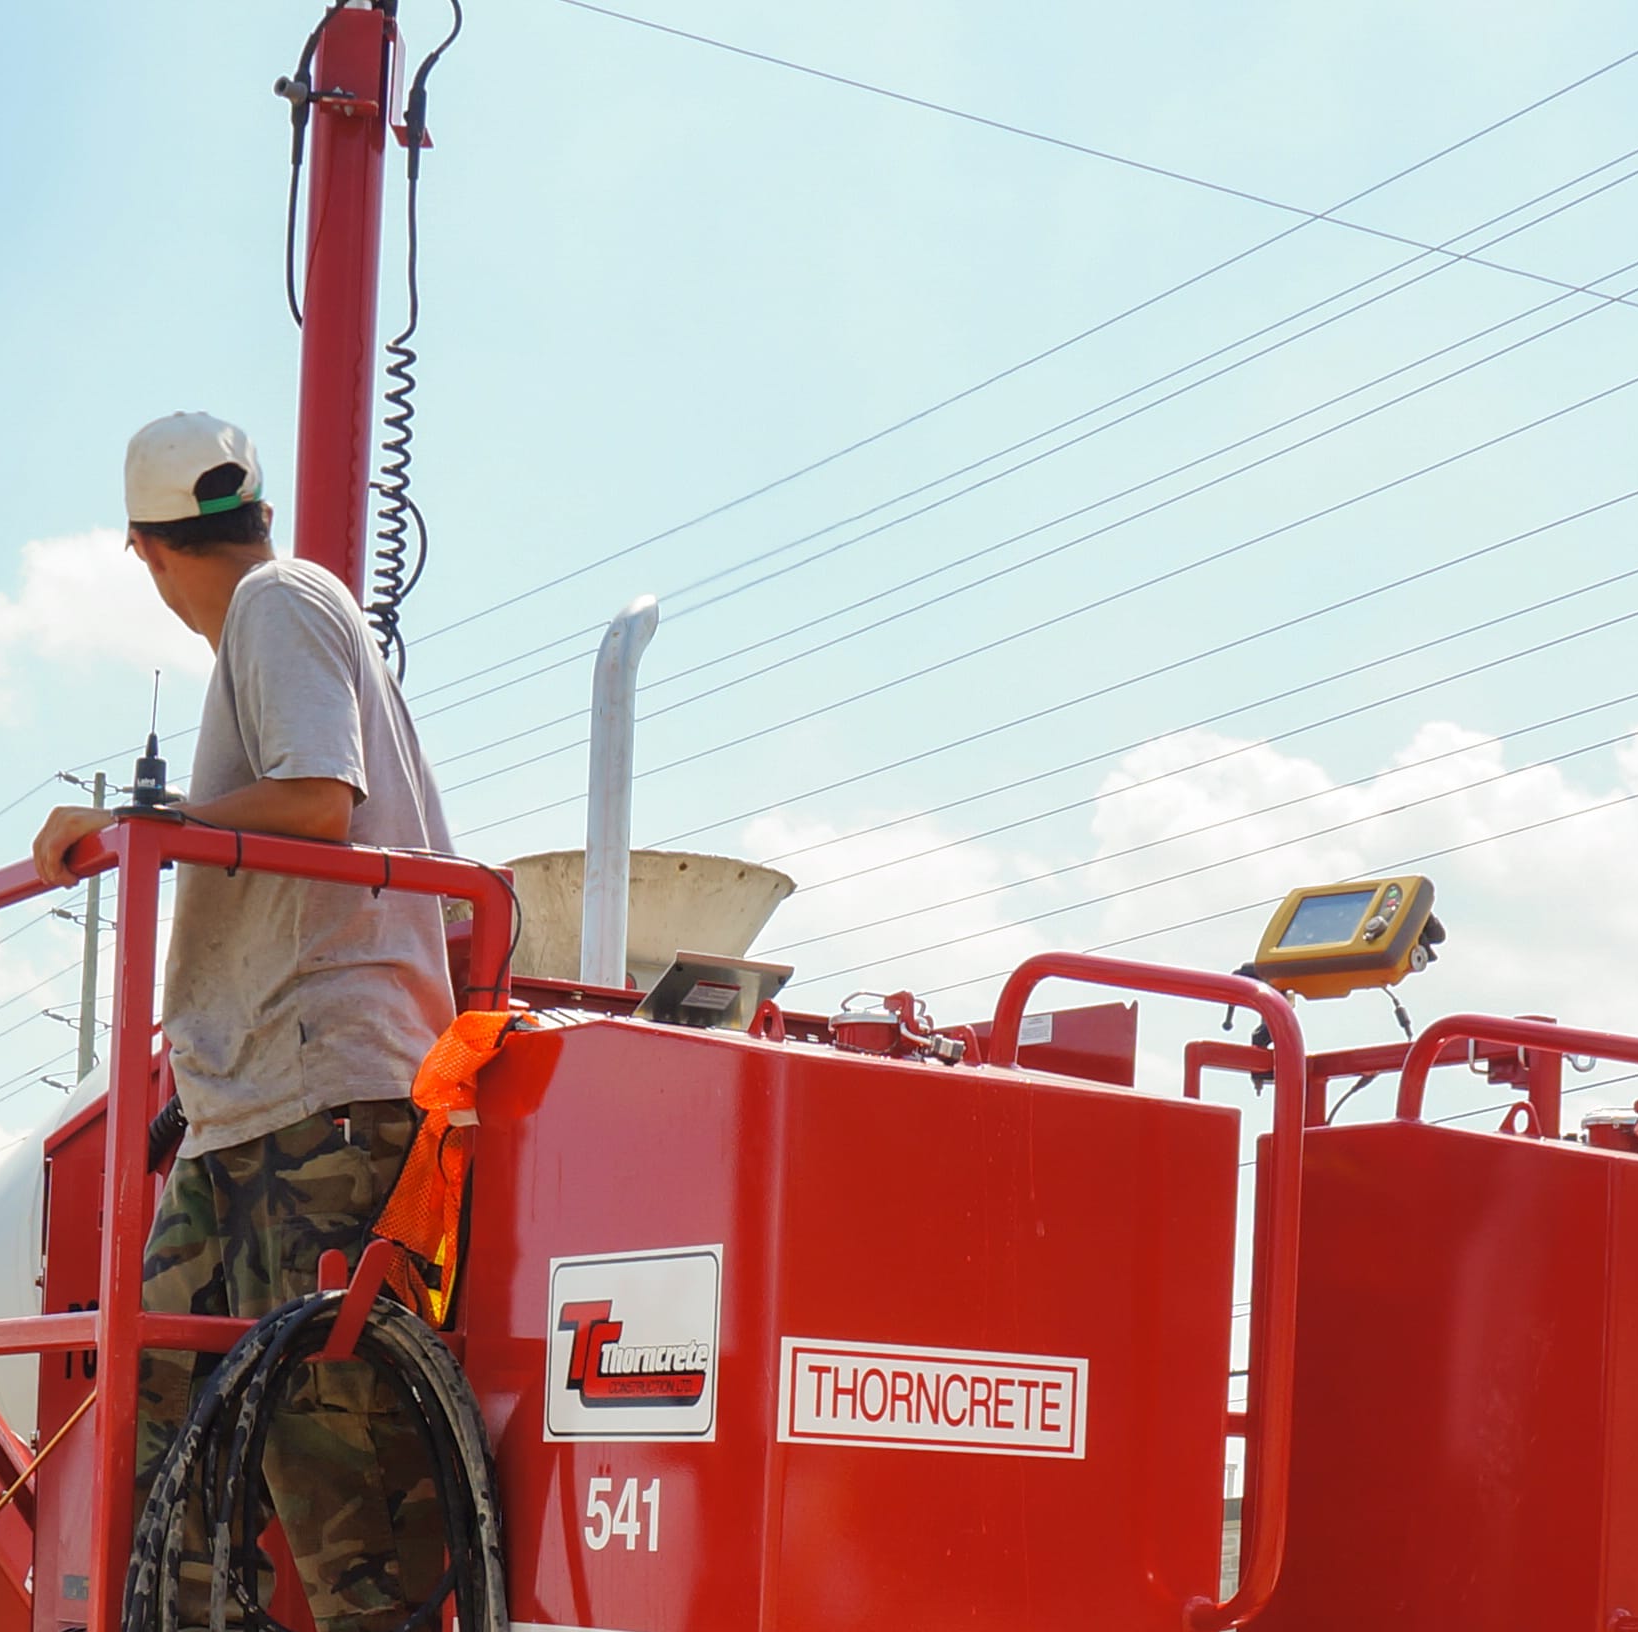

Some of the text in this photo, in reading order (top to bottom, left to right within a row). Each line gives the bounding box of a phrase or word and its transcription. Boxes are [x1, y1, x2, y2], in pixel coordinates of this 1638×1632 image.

[600, 1340, 709, 1374] Thorncrete
[608, 1380, 674, 1394] CONSTRUCTION
[808, 1364, 1062, 1432] THORNCRETE
[585, 1477, 660, 1552] 541
